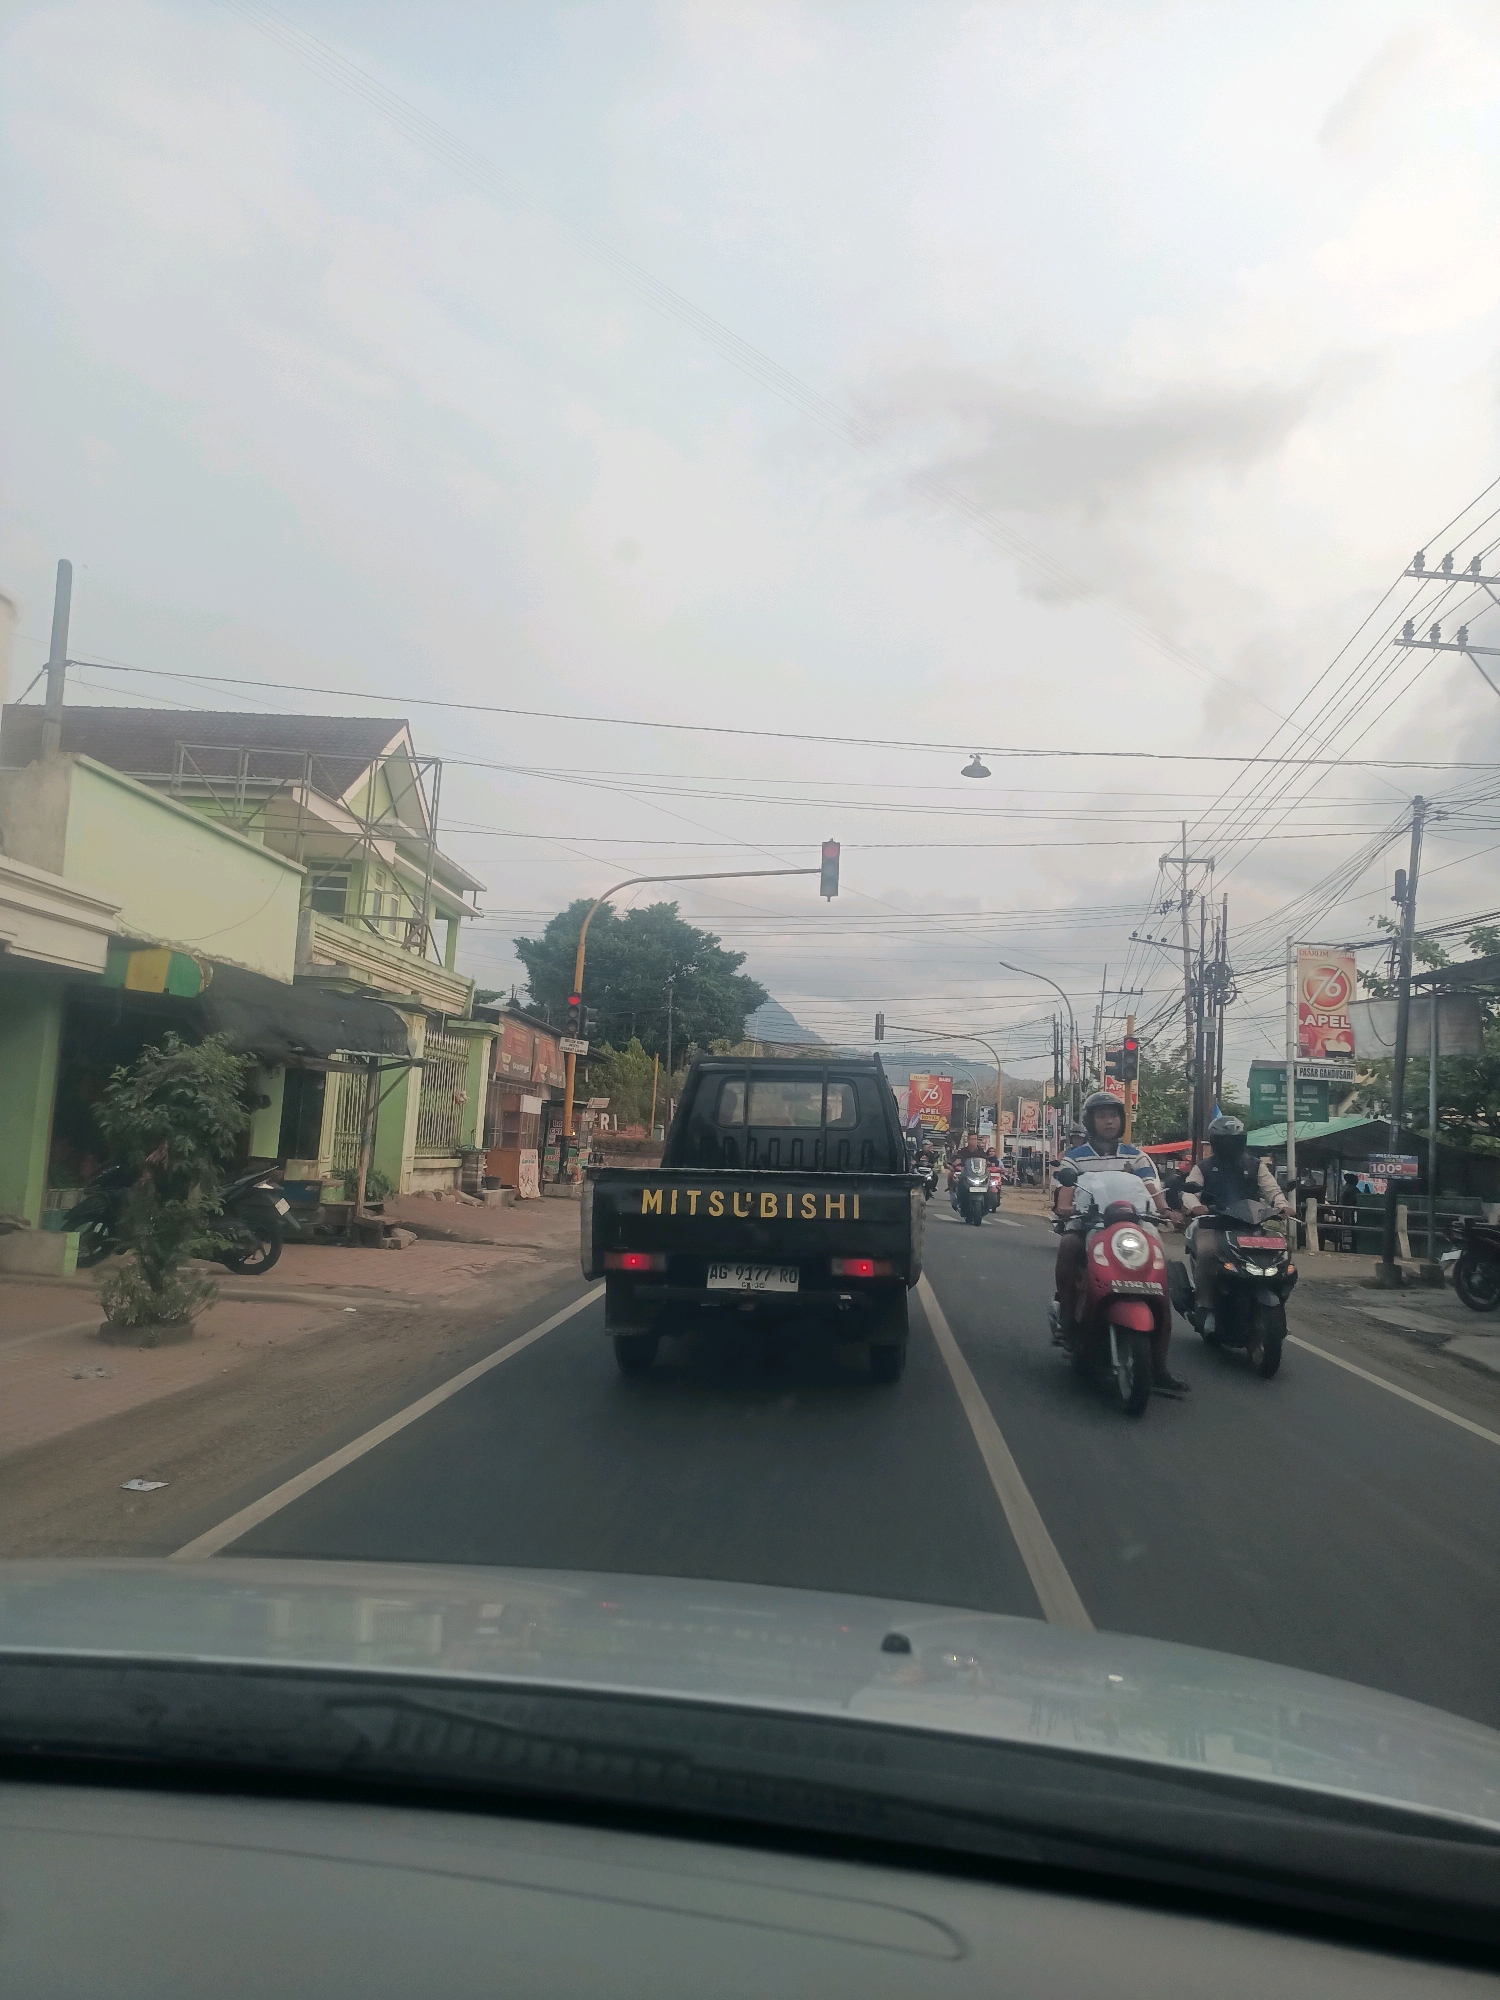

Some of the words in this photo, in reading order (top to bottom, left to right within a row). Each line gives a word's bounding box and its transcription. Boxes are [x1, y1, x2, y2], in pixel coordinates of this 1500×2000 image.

[1307, 967, 1344, 1006] 76
[1303, 1014, 1352, 1029] APEL
[921, 1084, 939, 1104] 76
[919, 1107, 941, 1115] APEL
[641, 1188, 860, 1219] MITSUBISHI
[709, 1264, 728, 1279] AG
[735, 1265, 771, 1282] 9177
